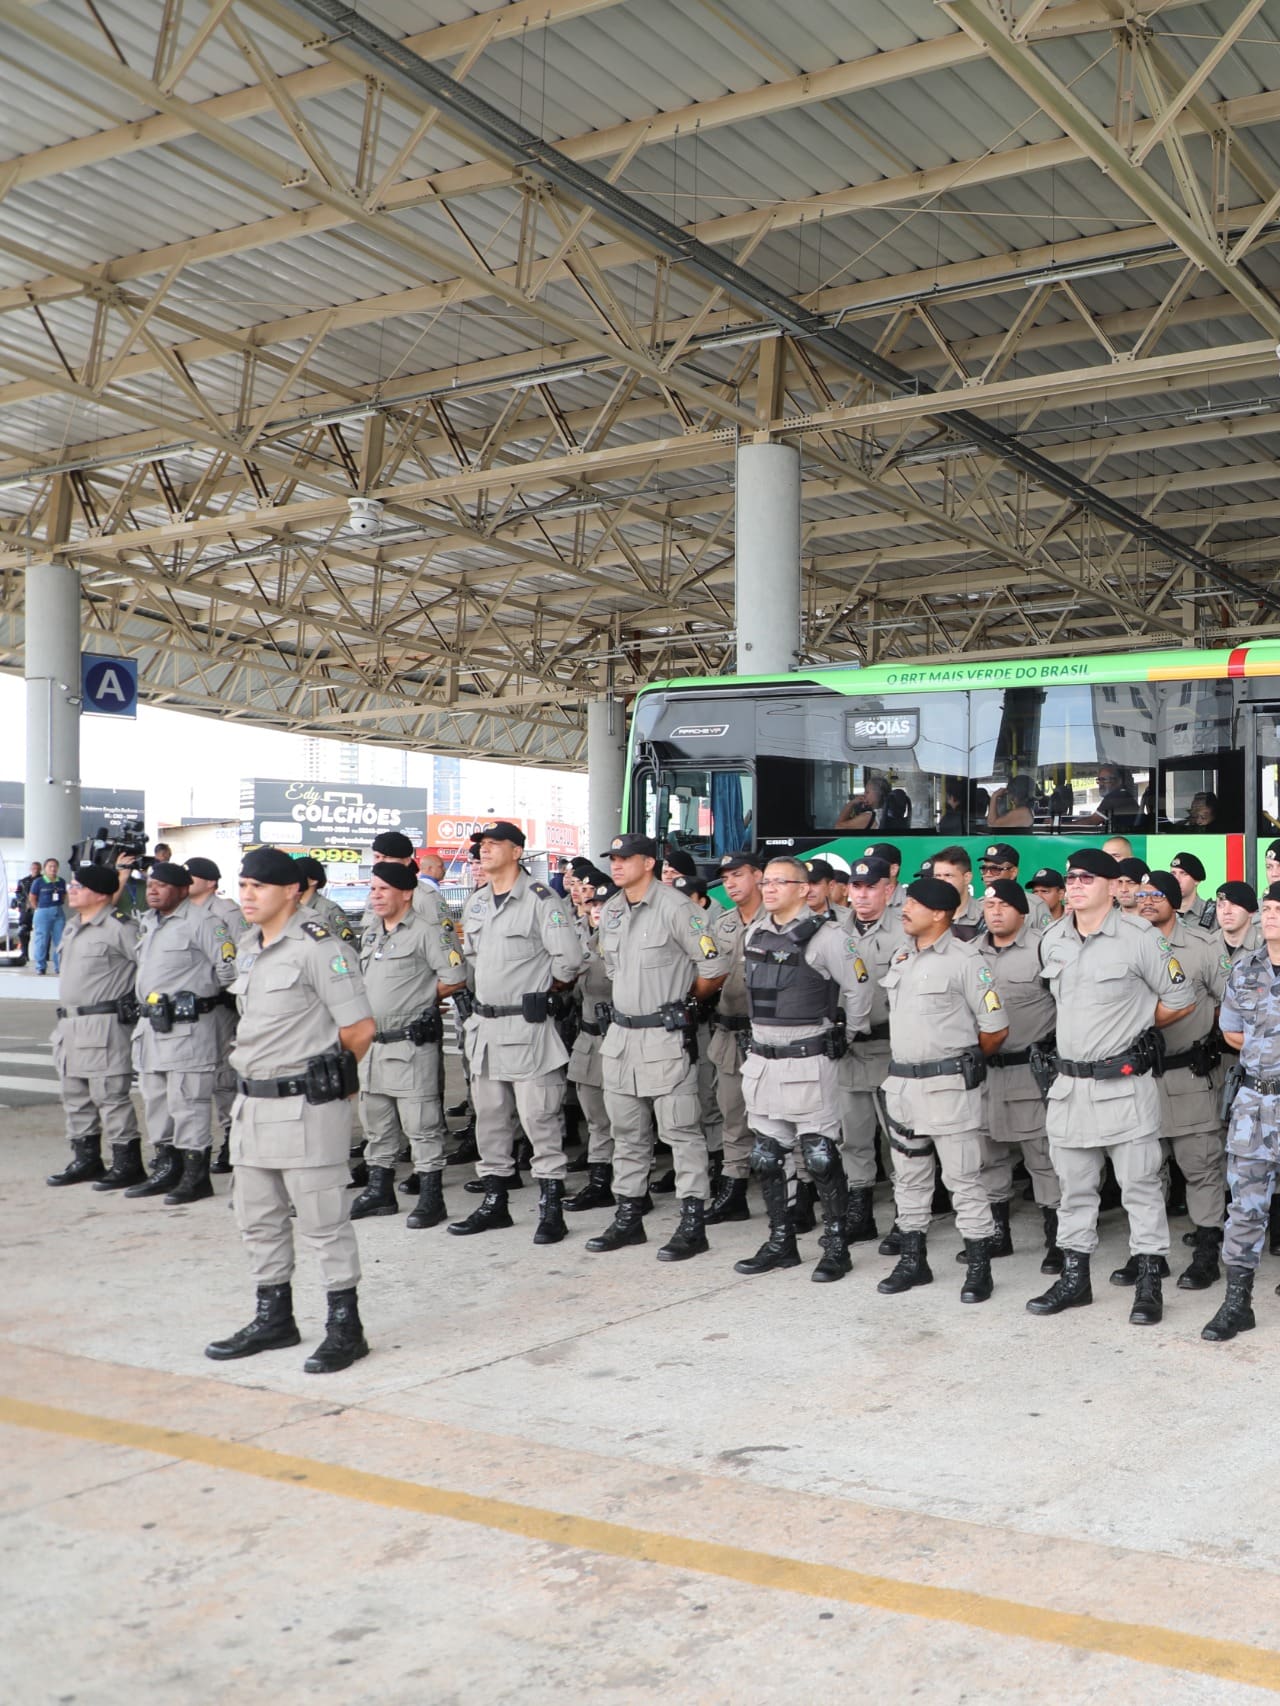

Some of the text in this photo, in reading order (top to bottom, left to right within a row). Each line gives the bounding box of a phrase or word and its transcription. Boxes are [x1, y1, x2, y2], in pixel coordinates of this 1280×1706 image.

[95, 669, 126, 701] A
[887, 664, 1090, 685] O BRT MAIS VERDE DO BRASIL
[865, 717, 910, 735] GOIÁS
[285, 782, 321, 806] Edy
[292, 803, 402, 826] COLCHÕES
